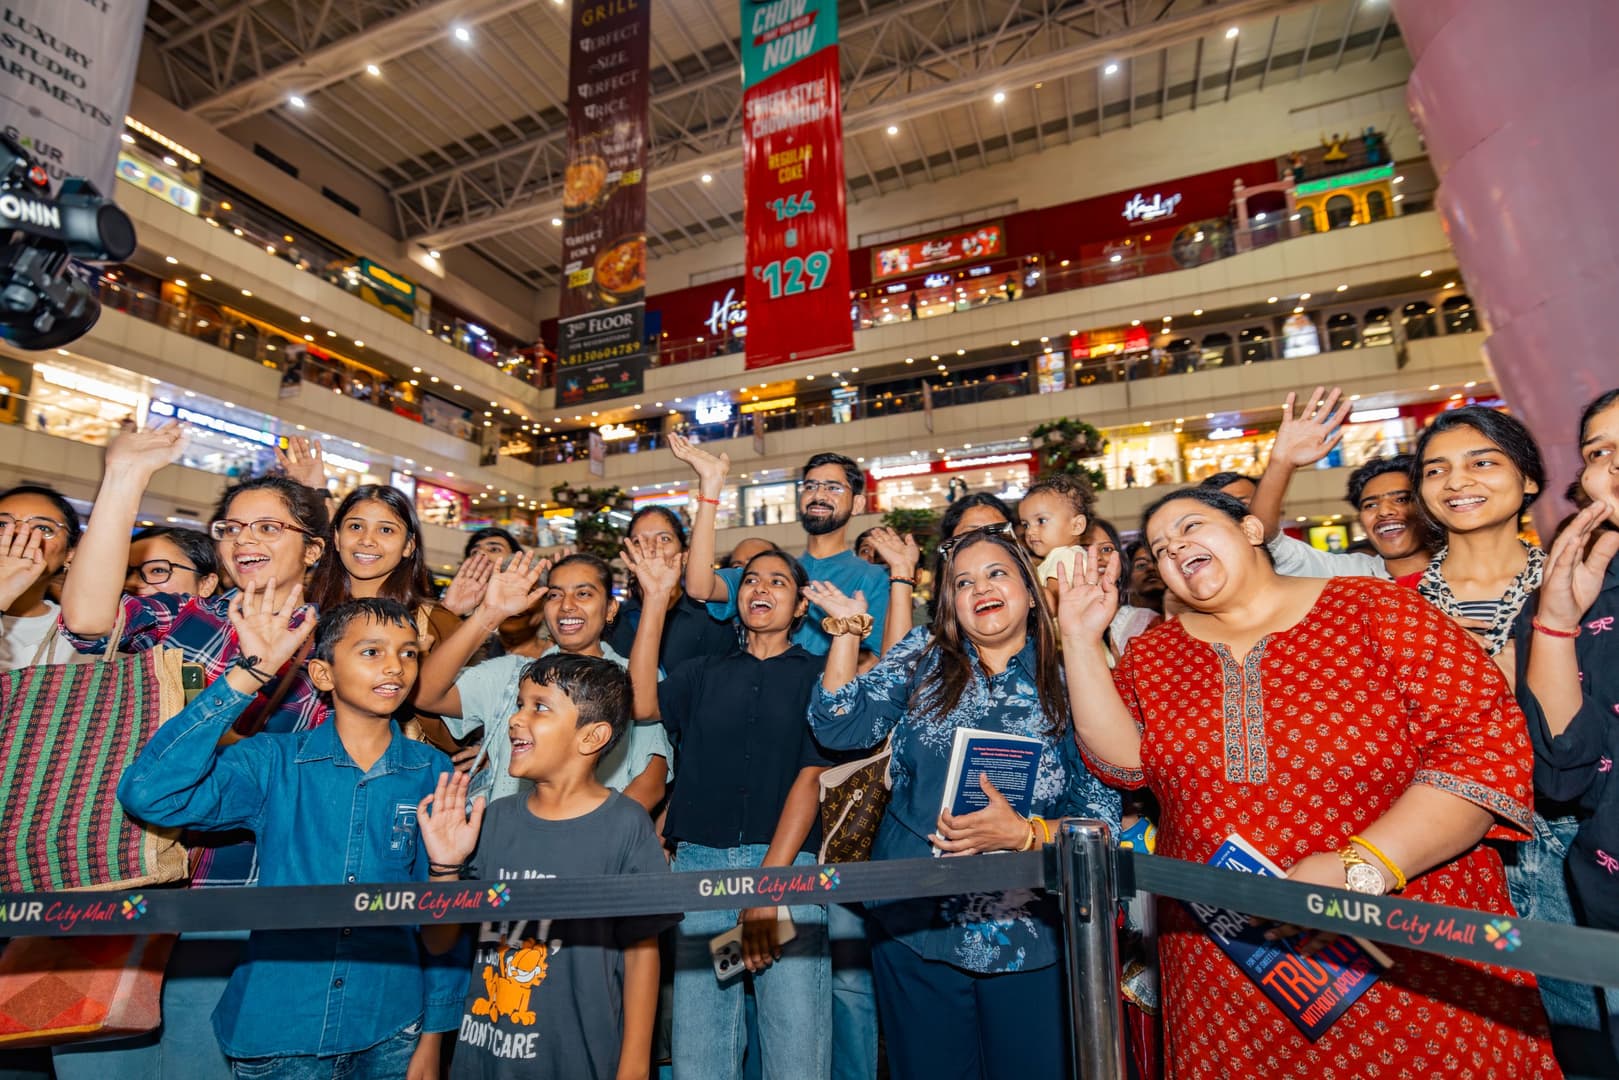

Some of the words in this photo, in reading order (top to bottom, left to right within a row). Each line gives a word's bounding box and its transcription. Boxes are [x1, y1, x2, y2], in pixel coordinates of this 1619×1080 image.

[581, 0, 638, 27] GRILL
[752, 0, 807, 35] CHOW
[3, 8, 92, 69] LUXURY
[762, 23, 817, 72] NOW
[1, 32, 86, 89] STUDIO
[768, 144, 813, 170] REGULAR
[778, 164, 803, 184] COKE
[588, 313, 634, 334] FLOOR
[699, 875, 755, 897] GAUR
[757, 875, 787, 902] City
[788, 873, 816, 892] Mall
[45, 901, 82, 931] City
[82, 899, 117, 921] Mall
[354, 890, 416, 912] GAUR
[417, 890, 452, 919] City
[452, 889, 484, 909] Mall
[1306, 893, 1382, 927] GAUR
[1386, 909, 1431, 945] City
[1433, 919, 1477, 945] Mall
[1300, 987, 1340, 1028] WITHOUT
[493, 1028, 540, 1060] CARE
